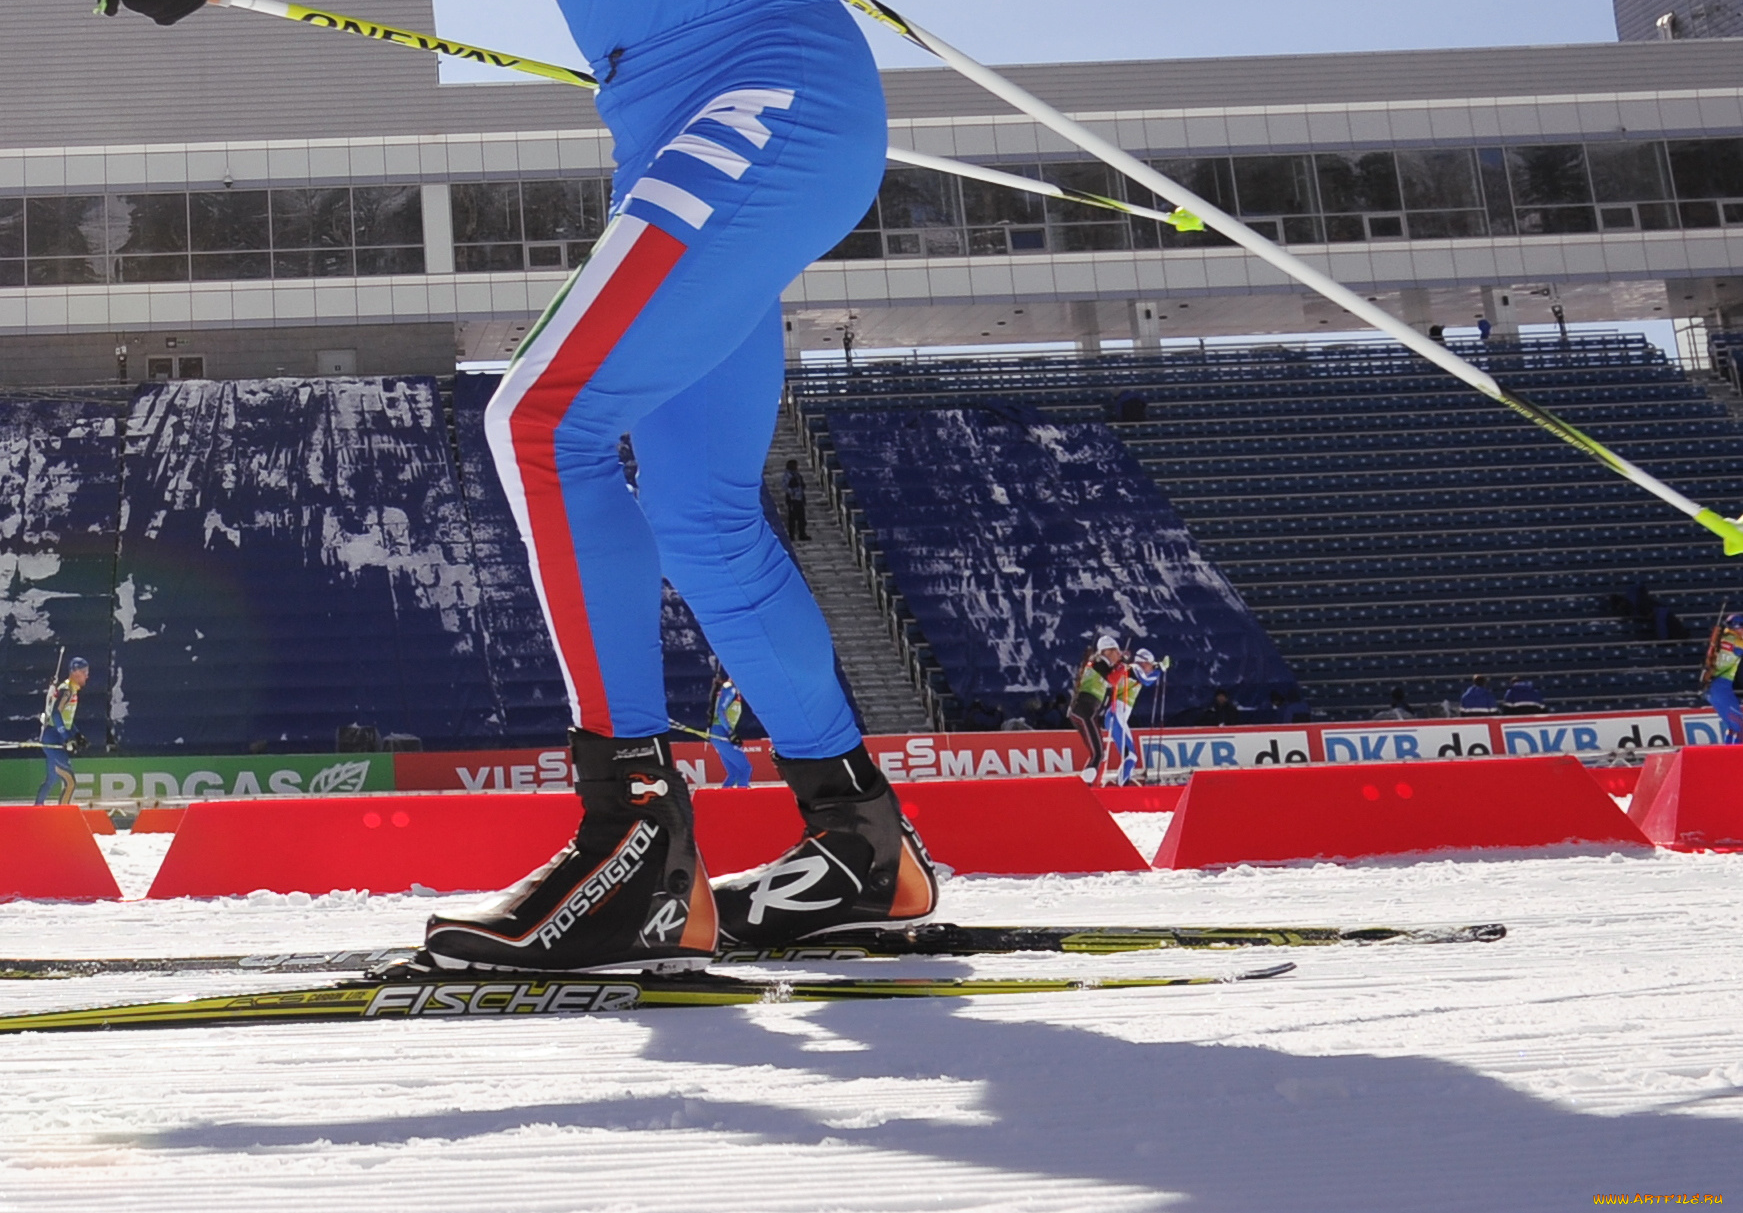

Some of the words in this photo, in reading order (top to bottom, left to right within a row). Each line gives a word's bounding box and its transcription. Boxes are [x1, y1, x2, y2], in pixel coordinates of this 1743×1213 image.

[537, 818, 660, 950] ROSSIGNOL
[747, 854, 844, 926] R
[644, 898, 687, 942] R
[363, 983, 641, 1017] FISCHER
